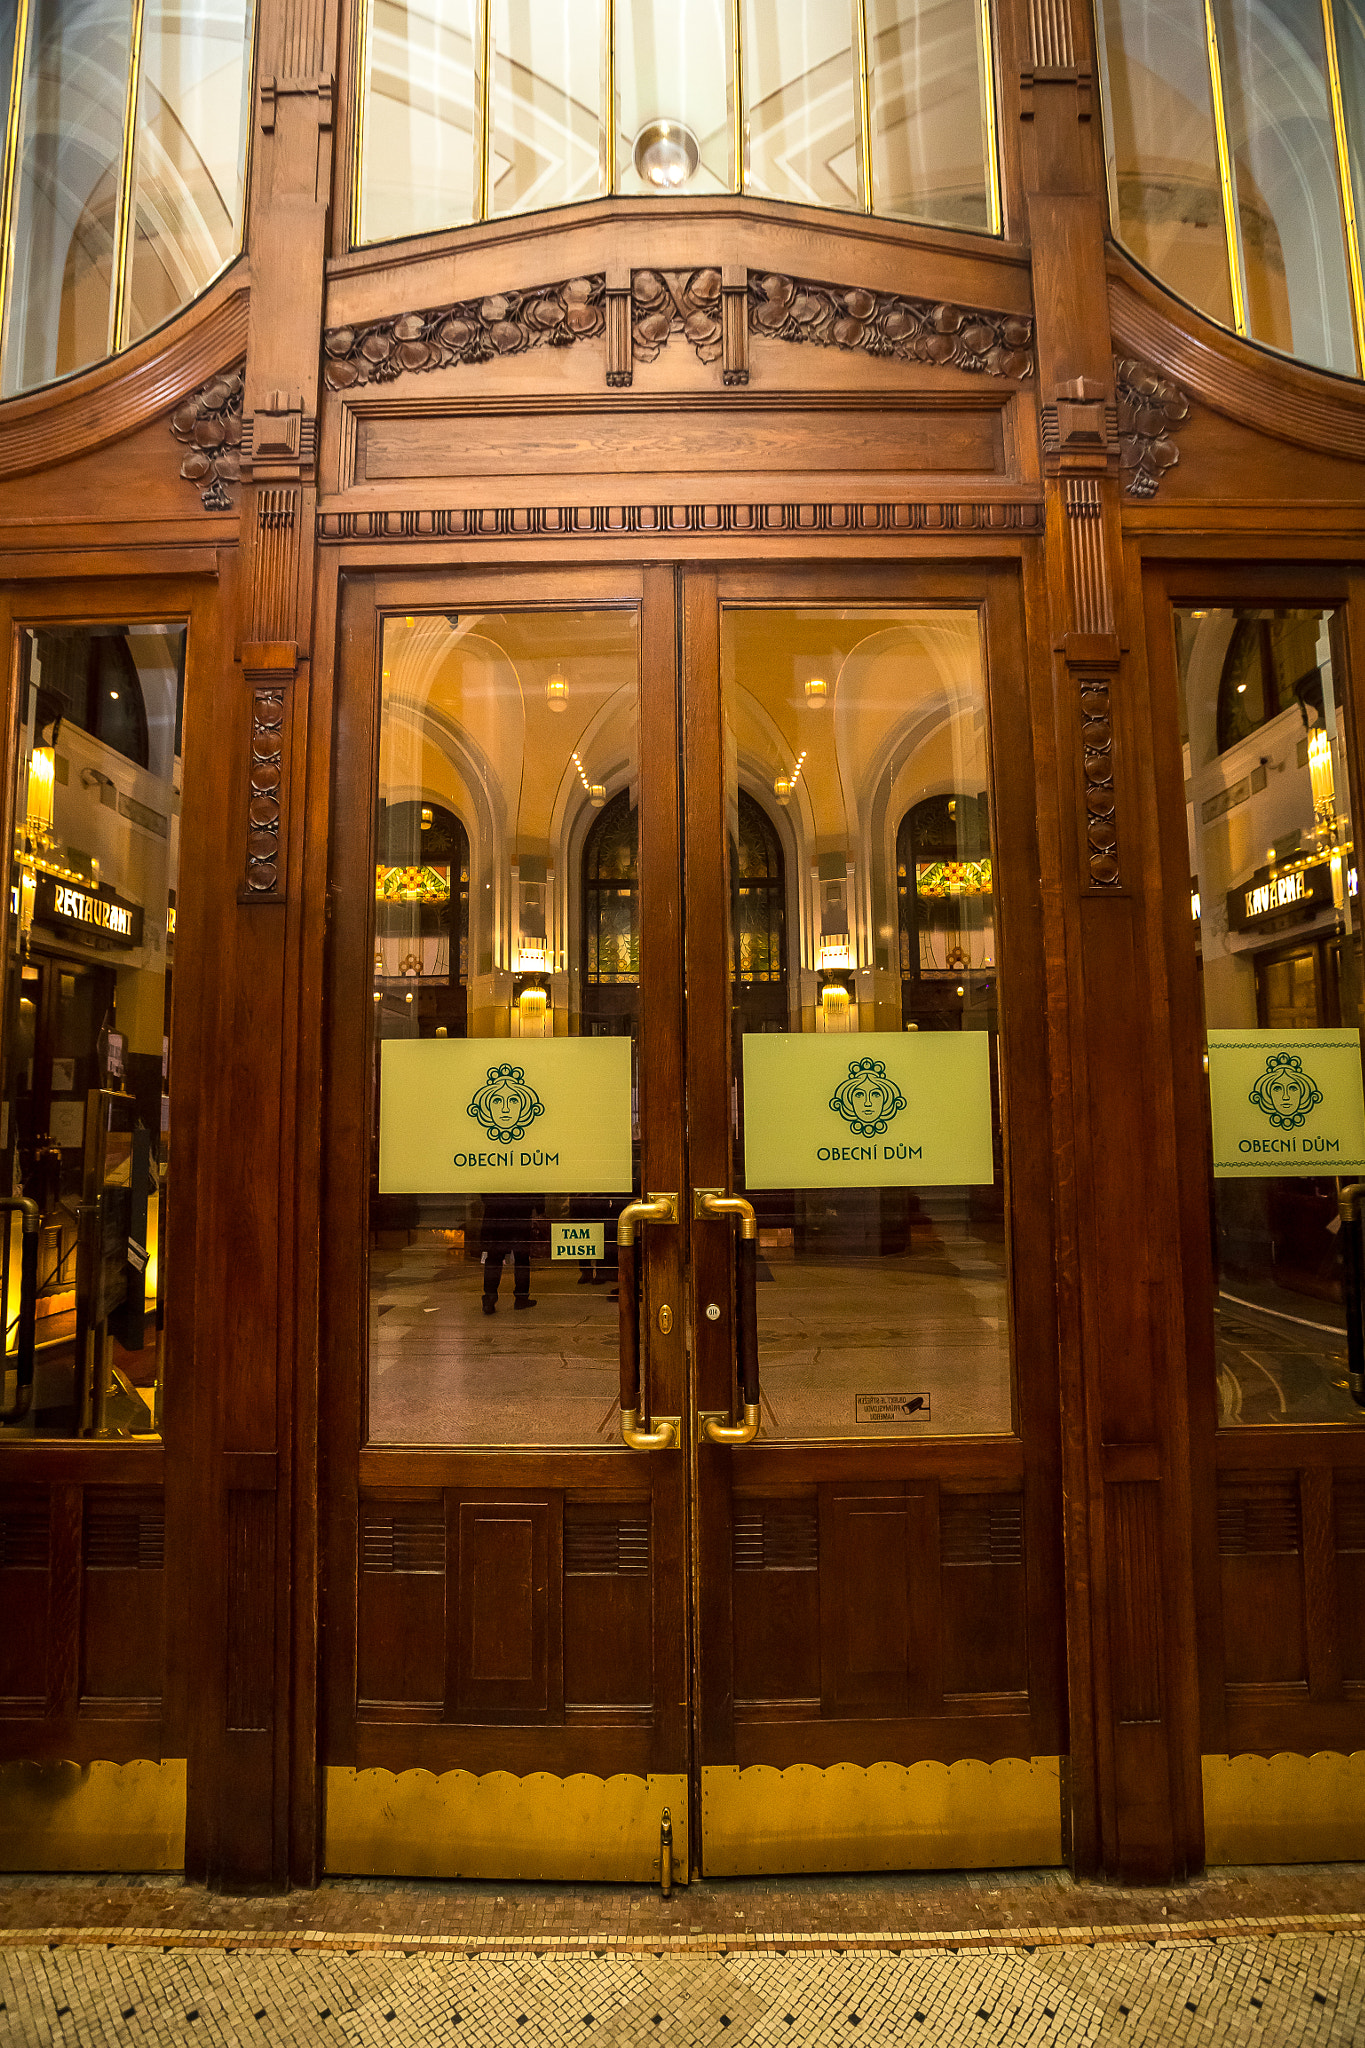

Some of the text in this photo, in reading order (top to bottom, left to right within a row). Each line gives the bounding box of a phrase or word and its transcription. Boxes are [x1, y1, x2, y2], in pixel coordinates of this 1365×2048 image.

[1245, 871, 1305, 917] KAVÁRNA
[54, 884, 133, 935] RESTAURANT
[817, 1143, 922, 1161] OBECNÍ DŮM
[1238, 1135, 1340, 1153] OBECNÍ DŮM
[453, 1149, 559, 1167] OBECNÍ DŮM
[561, 1228, 590, 1239] TAM
[556, 1245, 596, 1256] PUSH
